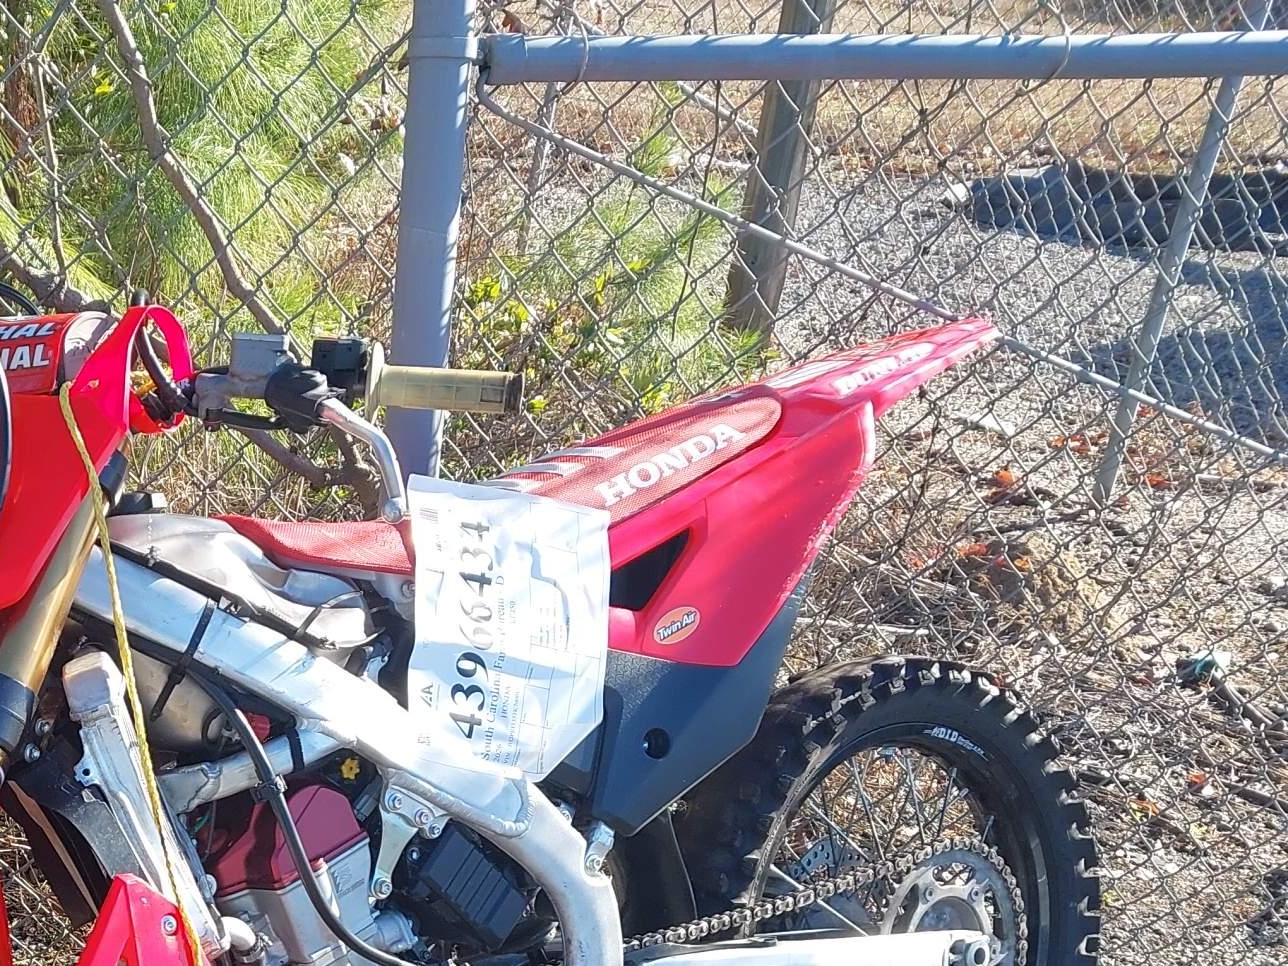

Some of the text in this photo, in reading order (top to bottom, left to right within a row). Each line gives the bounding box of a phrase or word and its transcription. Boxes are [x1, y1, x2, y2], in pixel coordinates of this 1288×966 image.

[593, 424, 746, 506] HONDA
[449, 521, 495, 739] 43966434
[657, 611, 697, 641] Twin Air
[481, 726, 497, 762] South
